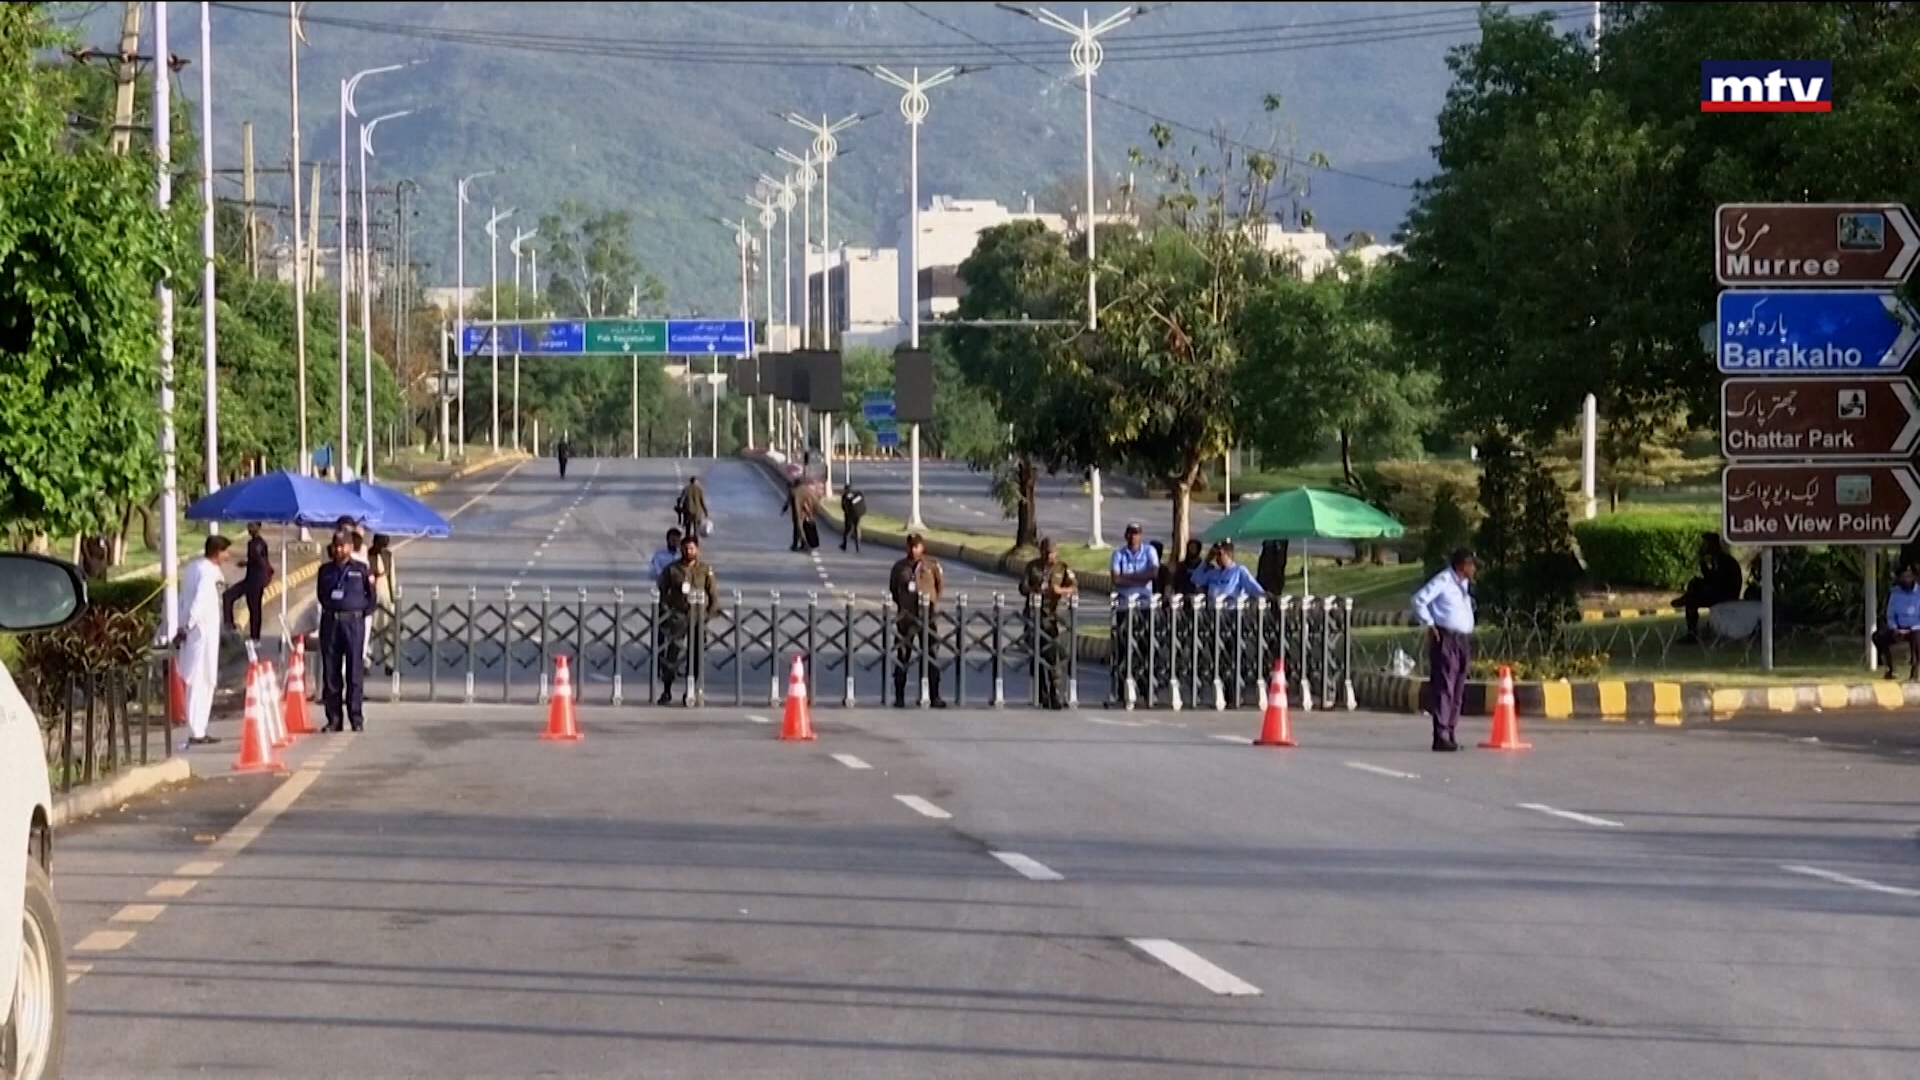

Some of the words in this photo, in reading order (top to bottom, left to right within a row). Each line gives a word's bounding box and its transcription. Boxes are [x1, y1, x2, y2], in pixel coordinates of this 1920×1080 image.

[1725, 213, 1770, 253] مری
[1726, 254, 1840, 276] Murree
[1723, 341, 1862, 367] Barakaho
[1728, 429, 1803, 448] Chattar
[1808, 429, 1855, 448] Park
[1729, 514, 1779, 533] Lake
[1784, 514, 1833, 532] View
[1838, 513, 1891, 532] Point
